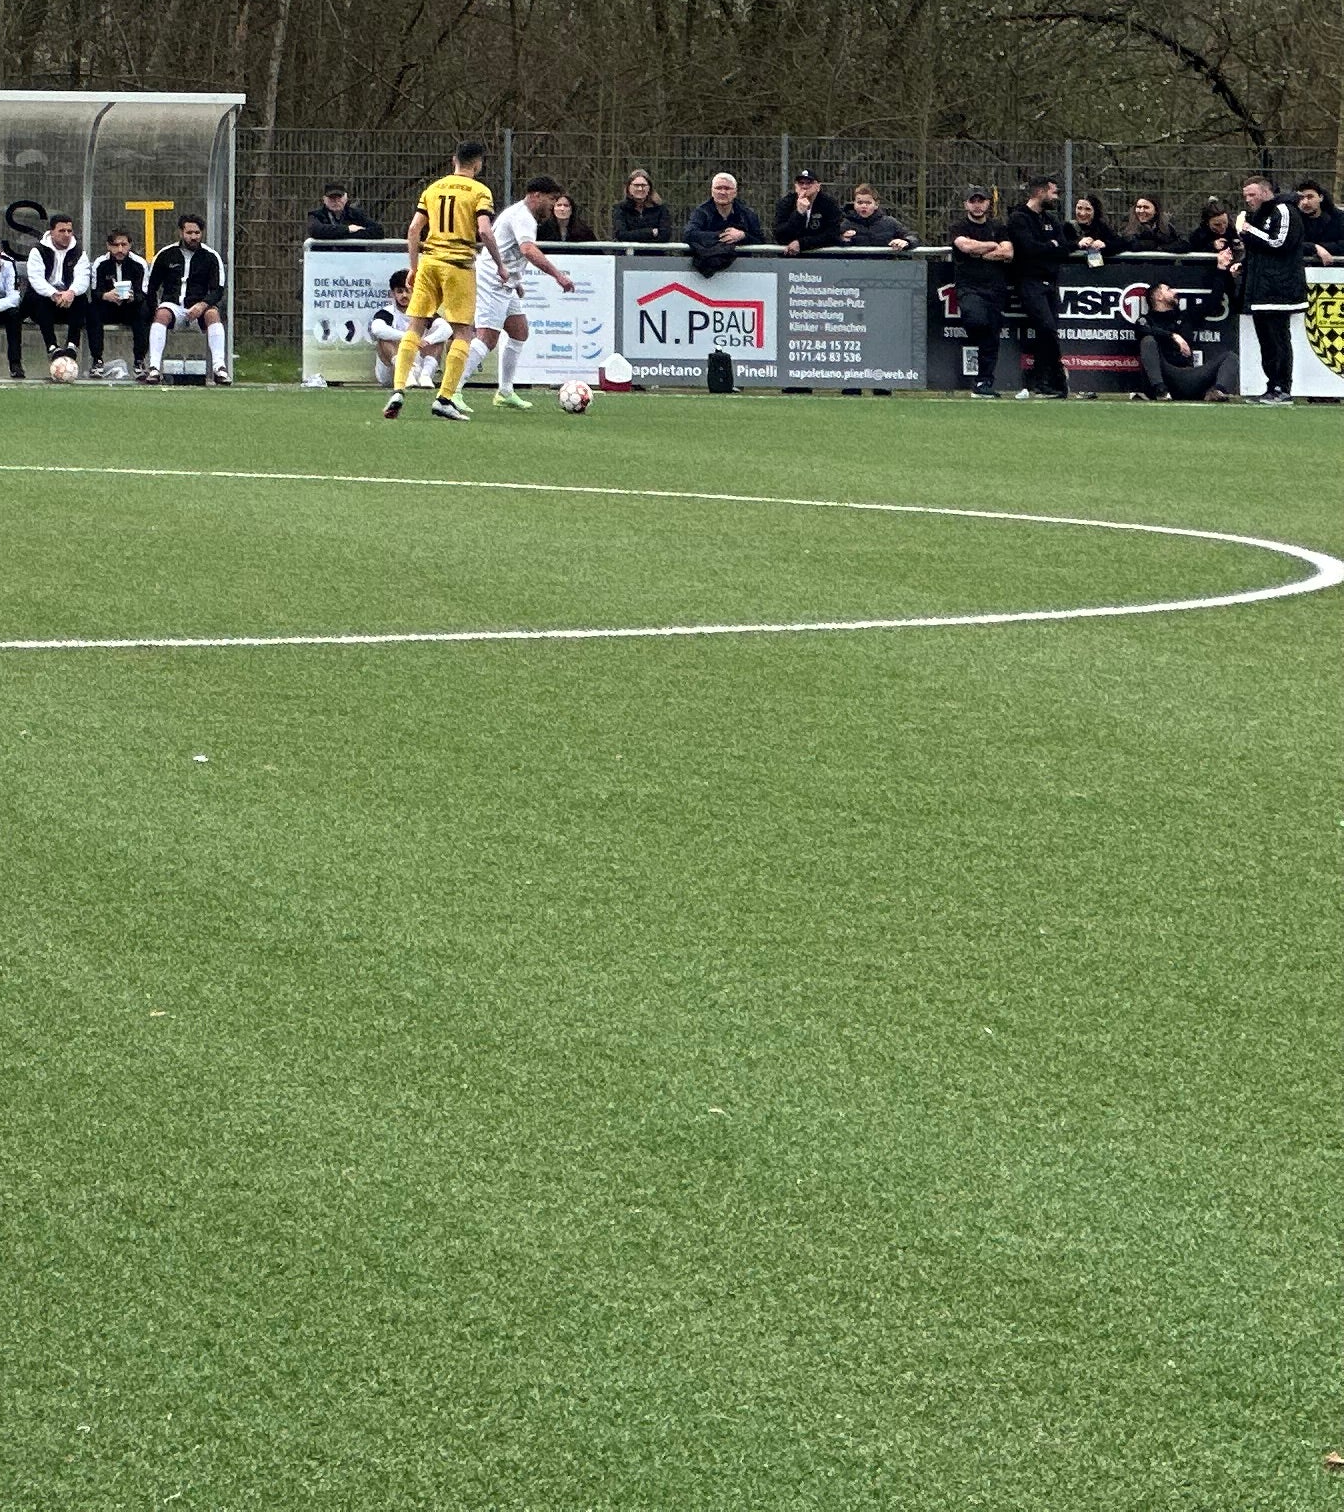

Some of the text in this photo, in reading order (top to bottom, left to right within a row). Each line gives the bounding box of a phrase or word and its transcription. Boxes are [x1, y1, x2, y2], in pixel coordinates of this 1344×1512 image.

[438, 194, 456, 233] 11
[314, 276, 372, 287] DIE KÖLNER
[788, 272, 822, 283] Rohbau
[789, 285, 860, 298] Altbausanierung
[314, 300, 331, 308] MIT
[333, 300, 355, 309] DEM
[713, 310, 756, 334] BAU
[789, 310, 844, 322] Verblendung
[712, 335, 755, 347] GbR
[830, 340, 842, 351] 15
[632, 365, 778, 378] apoletano Pinelli
